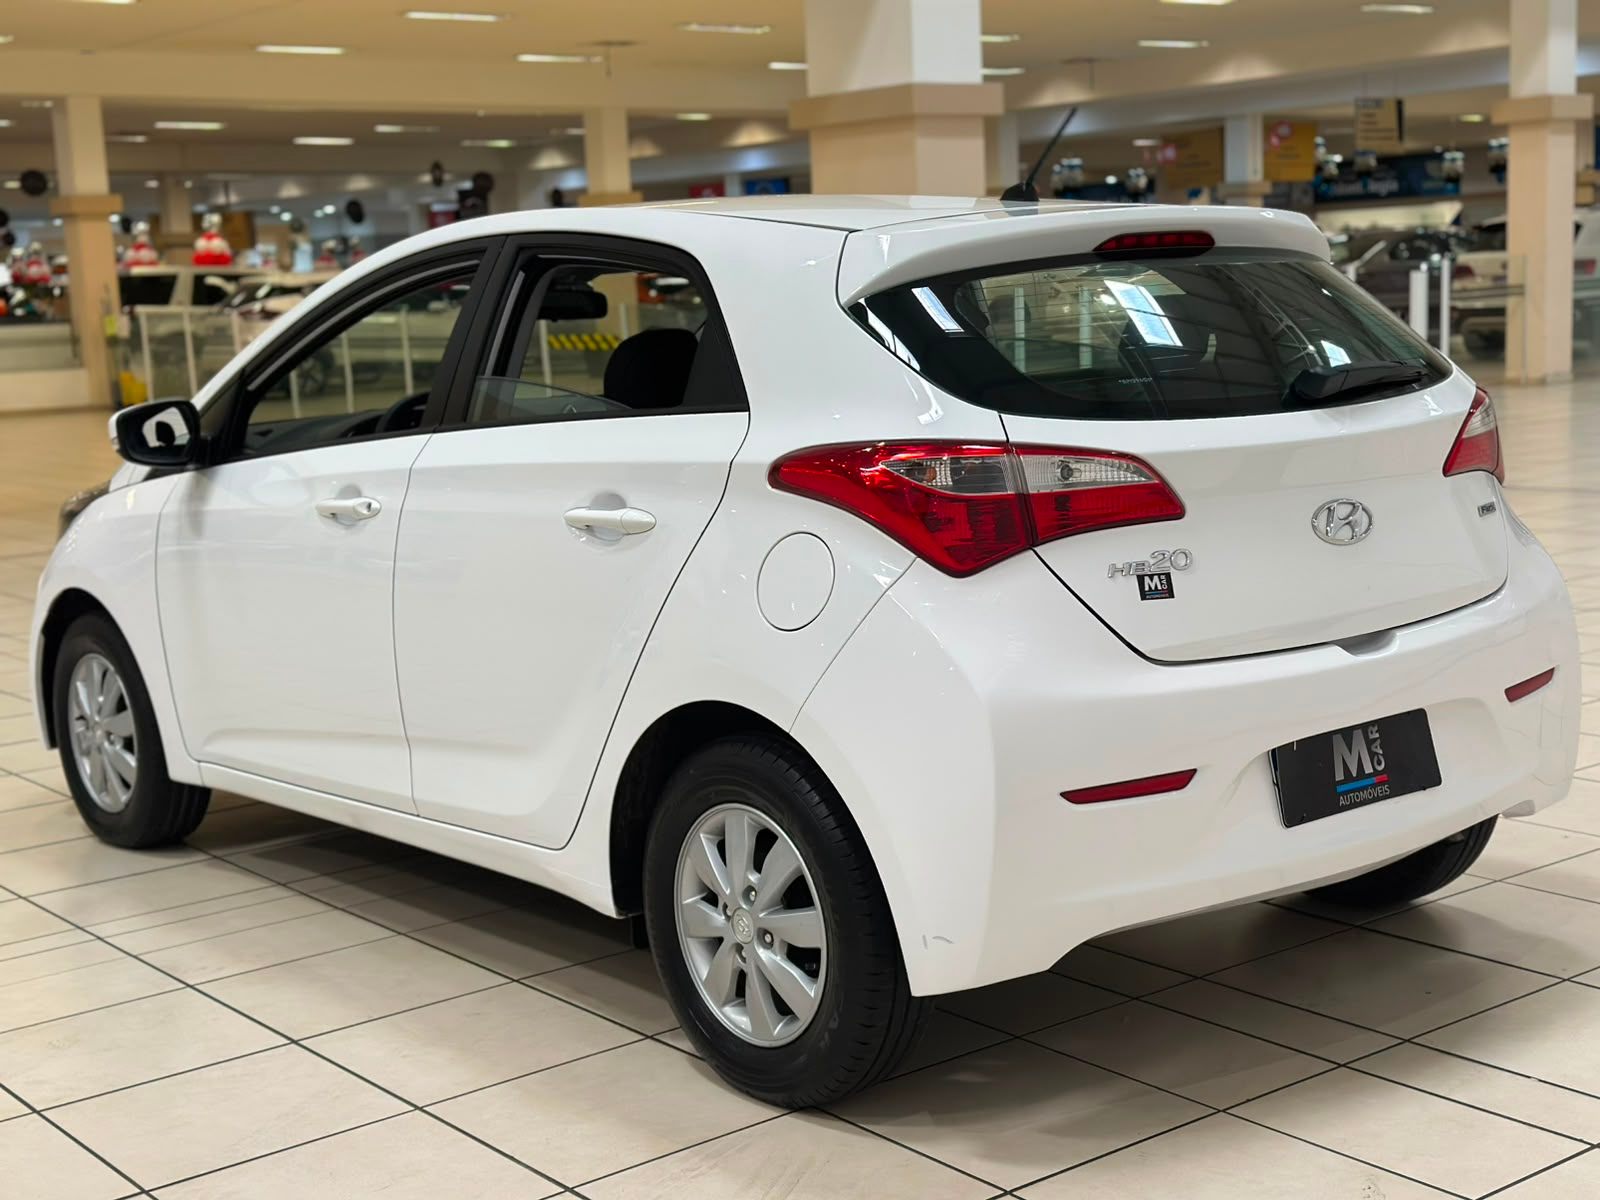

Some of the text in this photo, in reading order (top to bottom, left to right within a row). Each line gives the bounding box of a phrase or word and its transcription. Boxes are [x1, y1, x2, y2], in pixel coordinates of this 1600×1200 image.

[1107, 548, 1193, 578] HB20
[1144, 575, 1162, 591] M
[1332, 724, 1386, 781] M CAR
[1339, 784, 1390, 807] AUTOMÓVEIS
